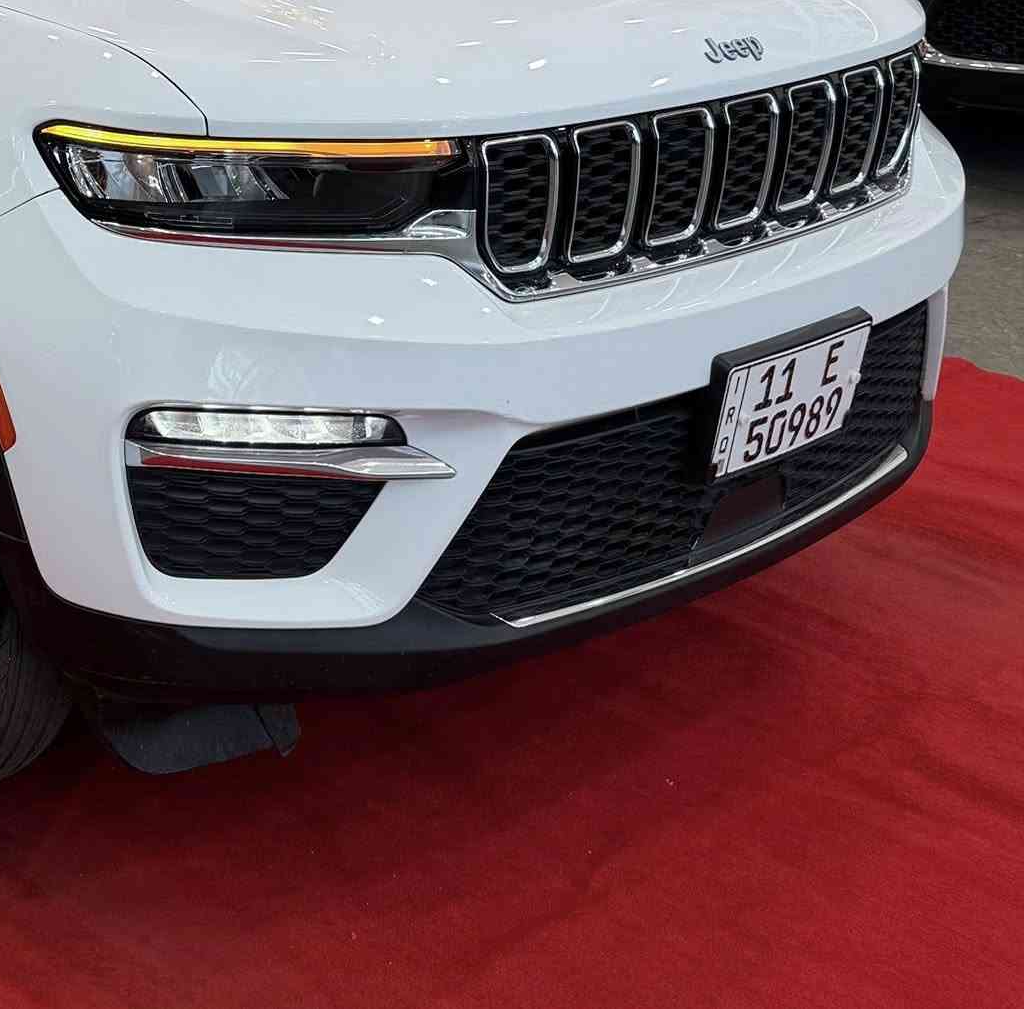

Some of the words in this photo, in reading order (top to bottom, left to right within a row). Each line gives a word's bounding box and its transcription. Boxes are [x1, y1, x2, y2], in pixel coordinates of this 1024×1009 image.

[704, 36, 764, 63] Jeep
[754, 357, 797, 412] 11
[821, 340, 845, 387] E
[743, 386, 843, 463] 50989
